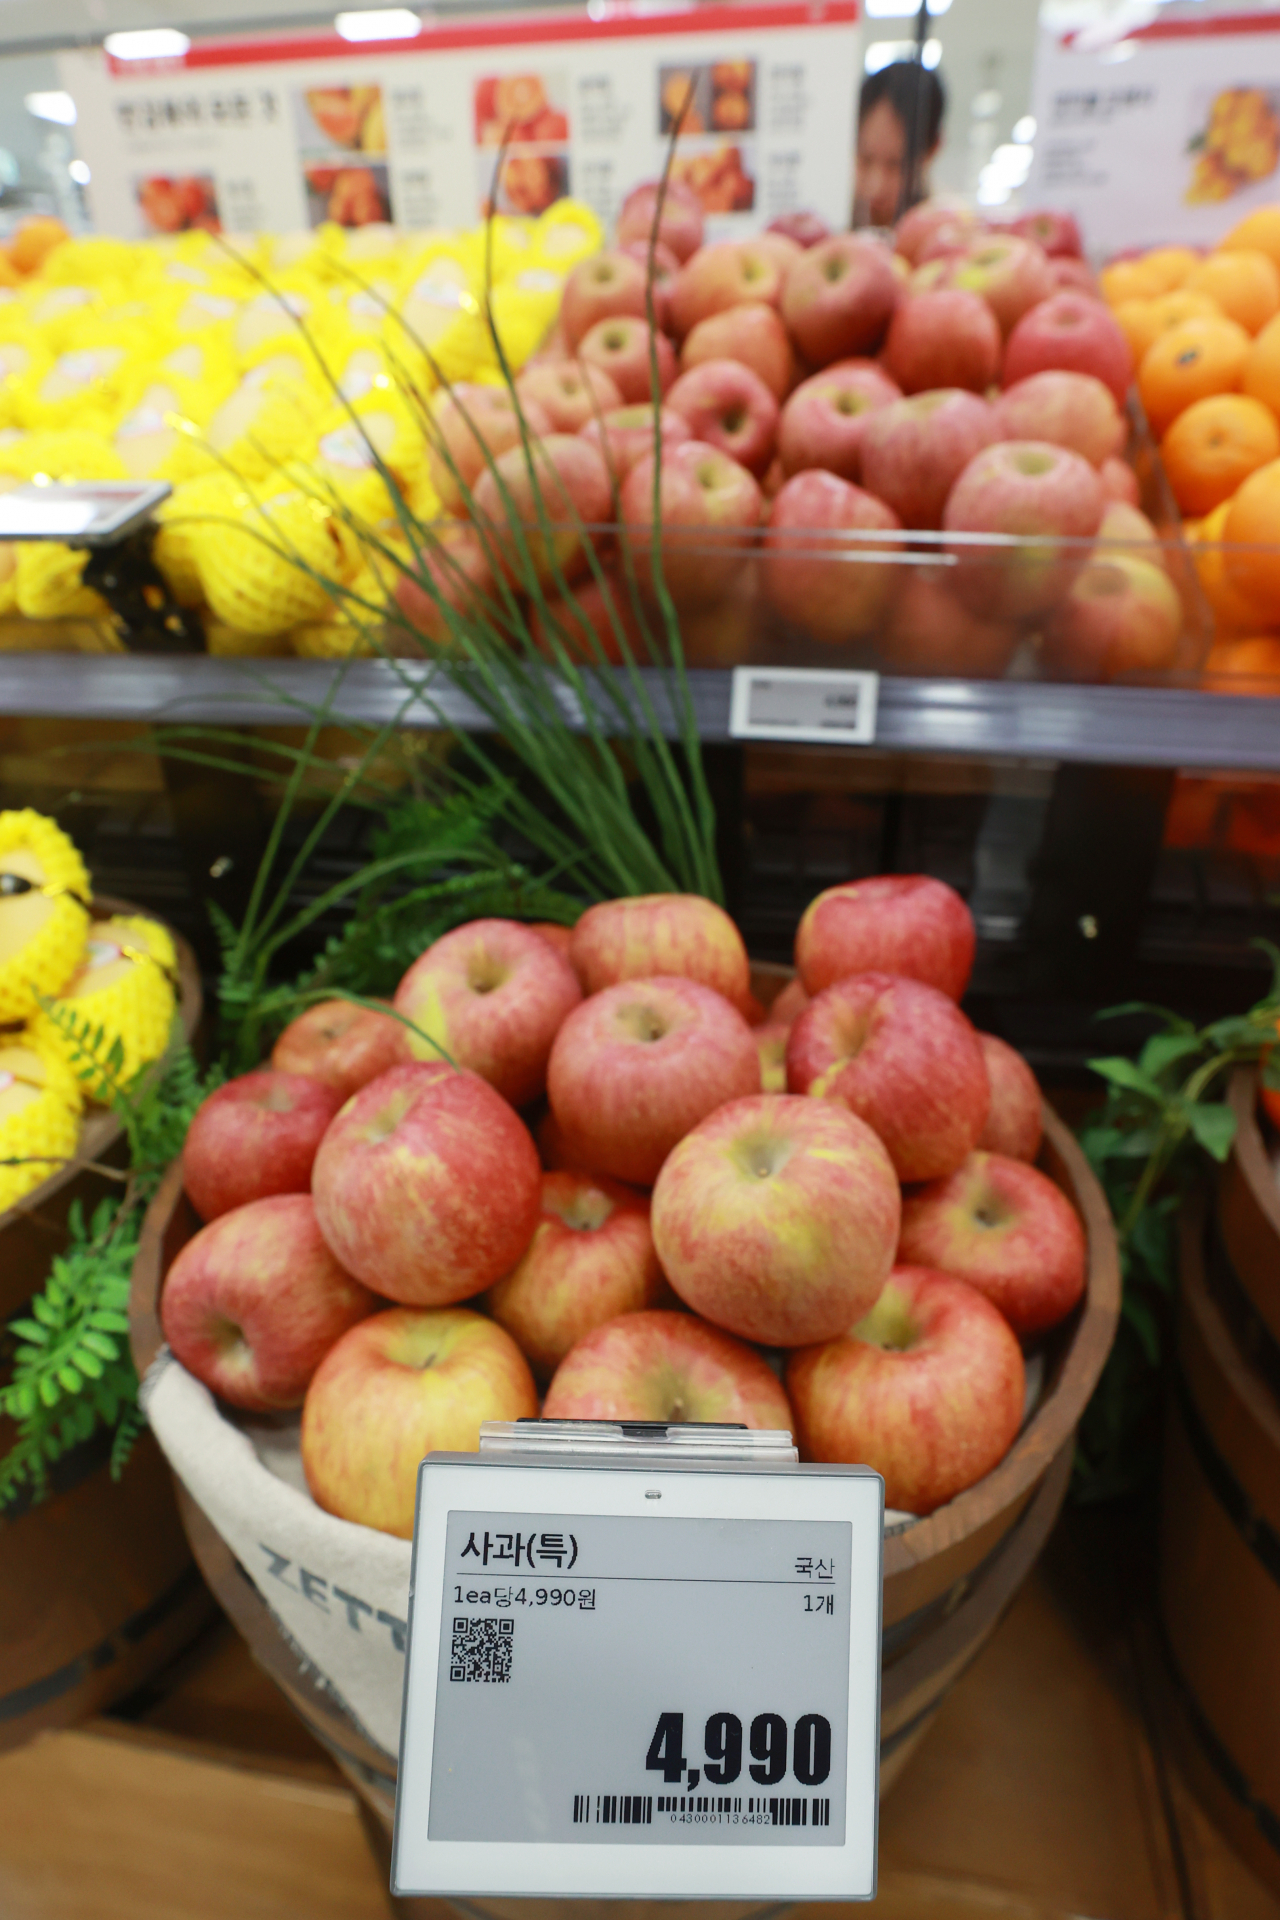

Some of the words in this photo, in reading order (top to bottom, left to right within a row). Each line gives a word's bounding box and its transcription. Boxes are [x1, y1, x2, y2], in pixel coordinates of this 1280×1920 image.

[460, 1531, 579, 1570] 사과(특)
[794, 1557, 836, 1579] 국산
[453, 1585, 596, 1611] 1ea당4,990원
[803, 1594, 834, 1616] 1개
[645, 1711, 833, 1792] 4,990
